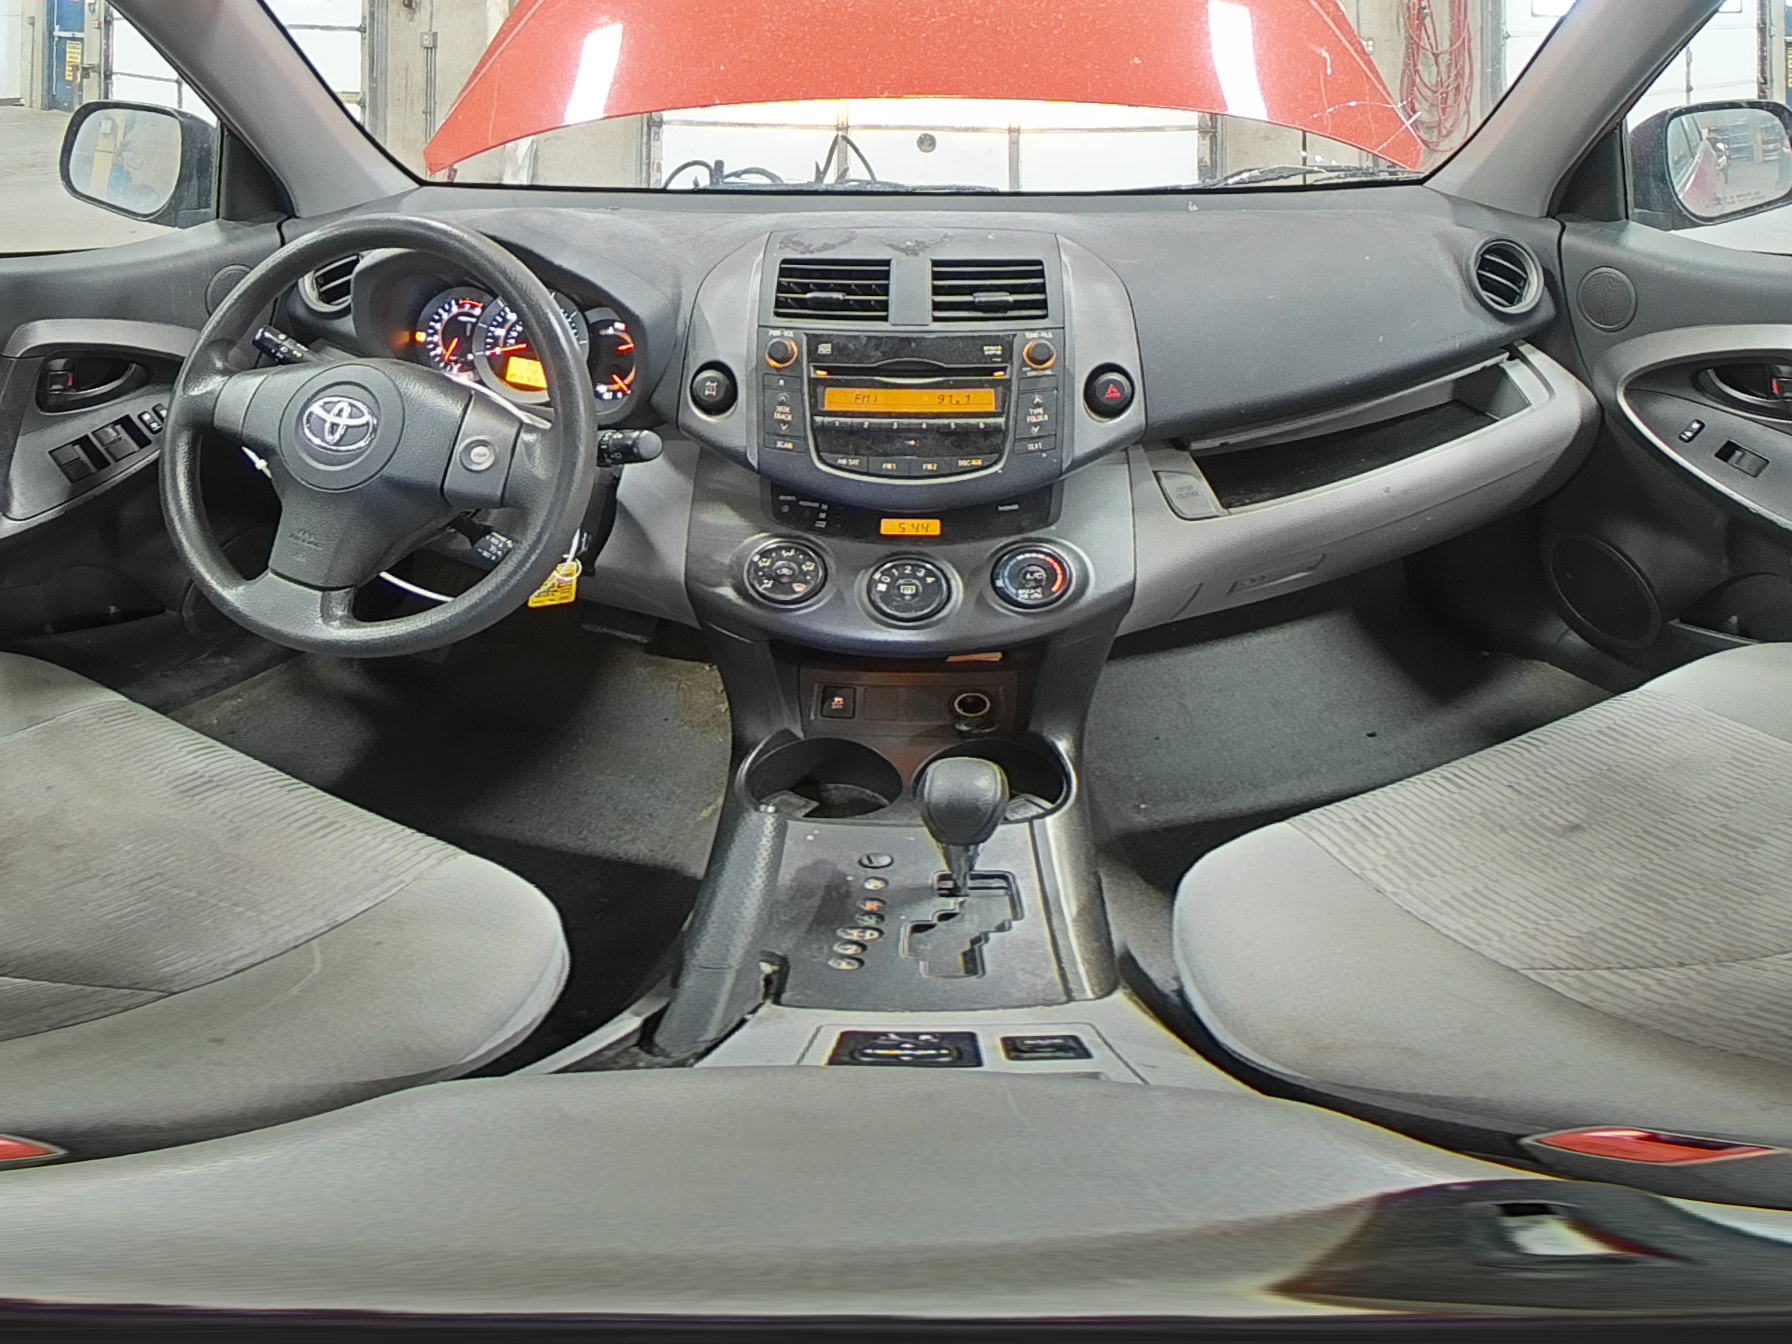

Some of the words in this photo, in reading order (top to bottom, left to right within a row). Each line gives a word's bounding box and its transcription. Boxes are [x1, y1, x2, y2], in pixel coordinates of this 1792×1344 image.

[937, 394, 972, 405] 91.1
[1029, 407, 1044, 415] TYPE
[904, 565, 912, 574] 2
[916, 568, 926, 577] 3
